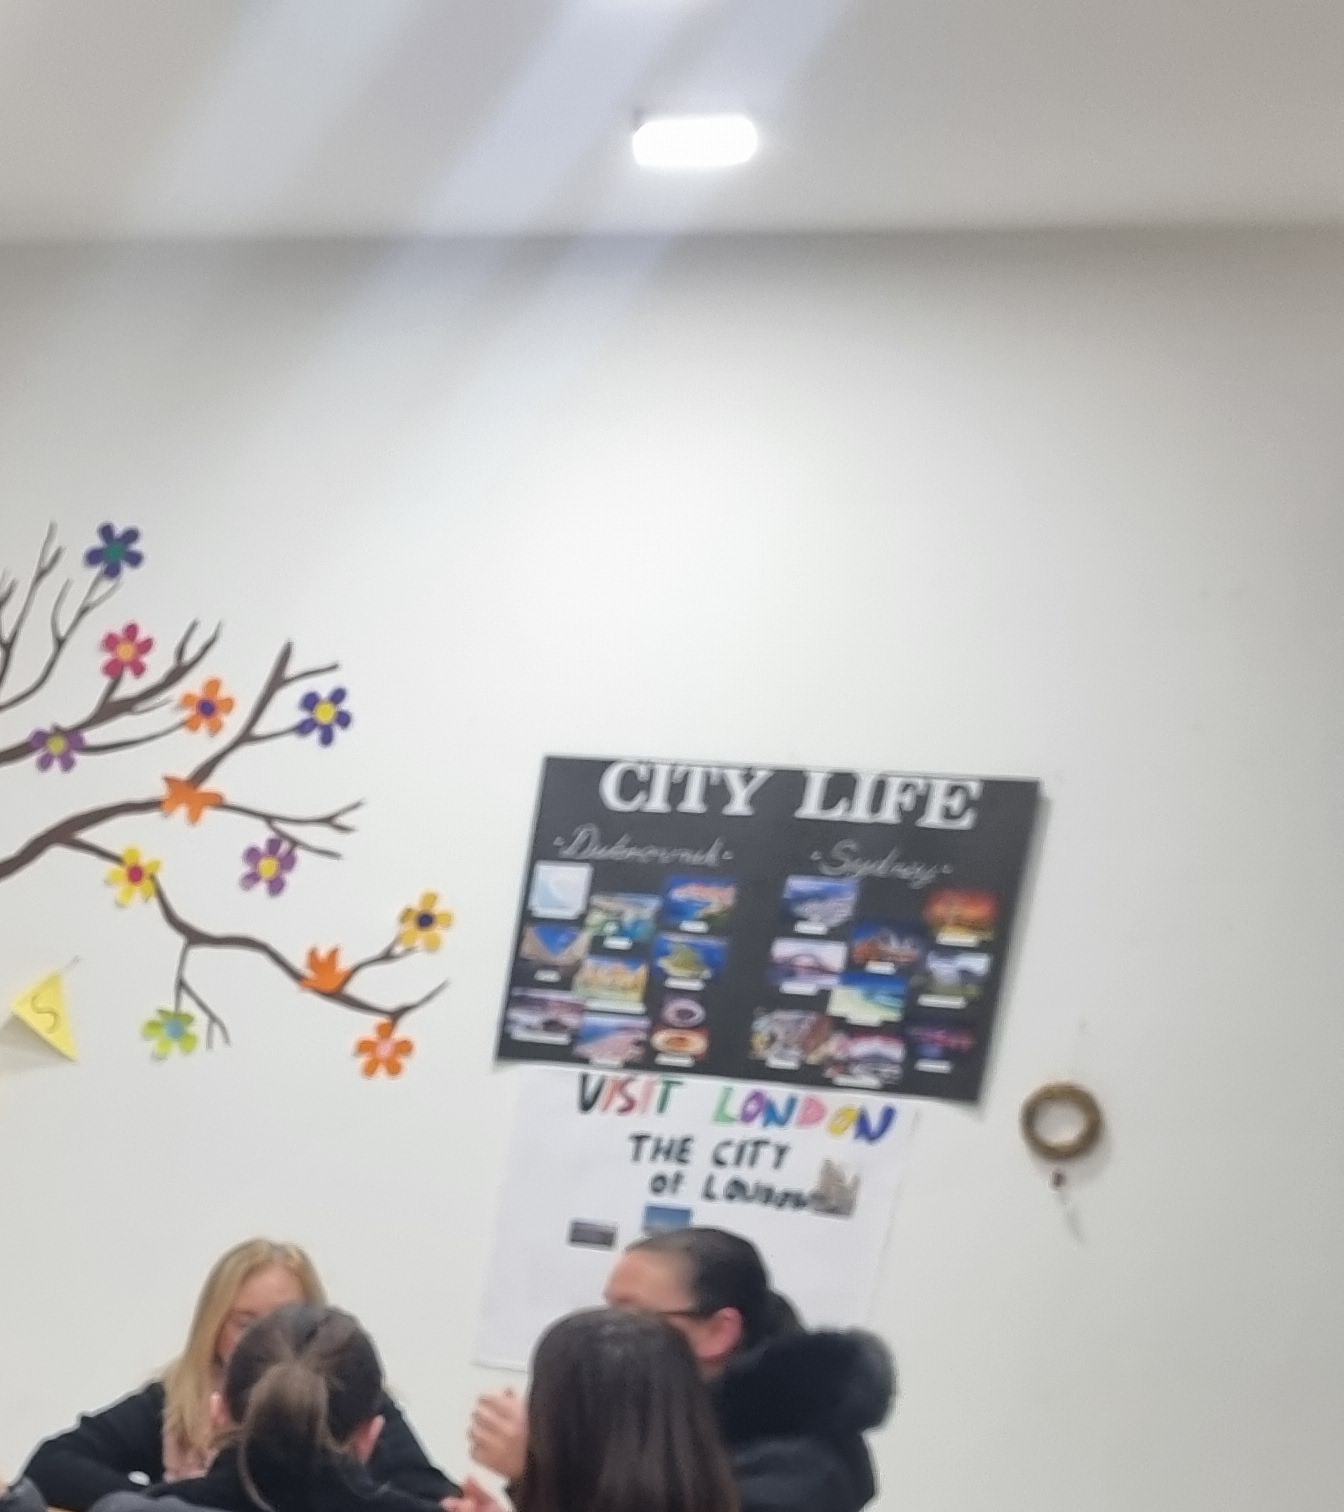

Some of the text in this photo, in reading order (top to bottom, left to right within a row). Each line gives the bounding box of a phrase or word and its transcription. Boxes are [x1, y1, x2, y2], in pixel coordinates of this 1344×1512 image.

[600, 760, 984, 831] CITY LIFE
[31, 994, 59, 1034] S
[576, 1072, 897, 1145] VISIT LONDON
[628, 1132, 791, 1170] THE CITY
